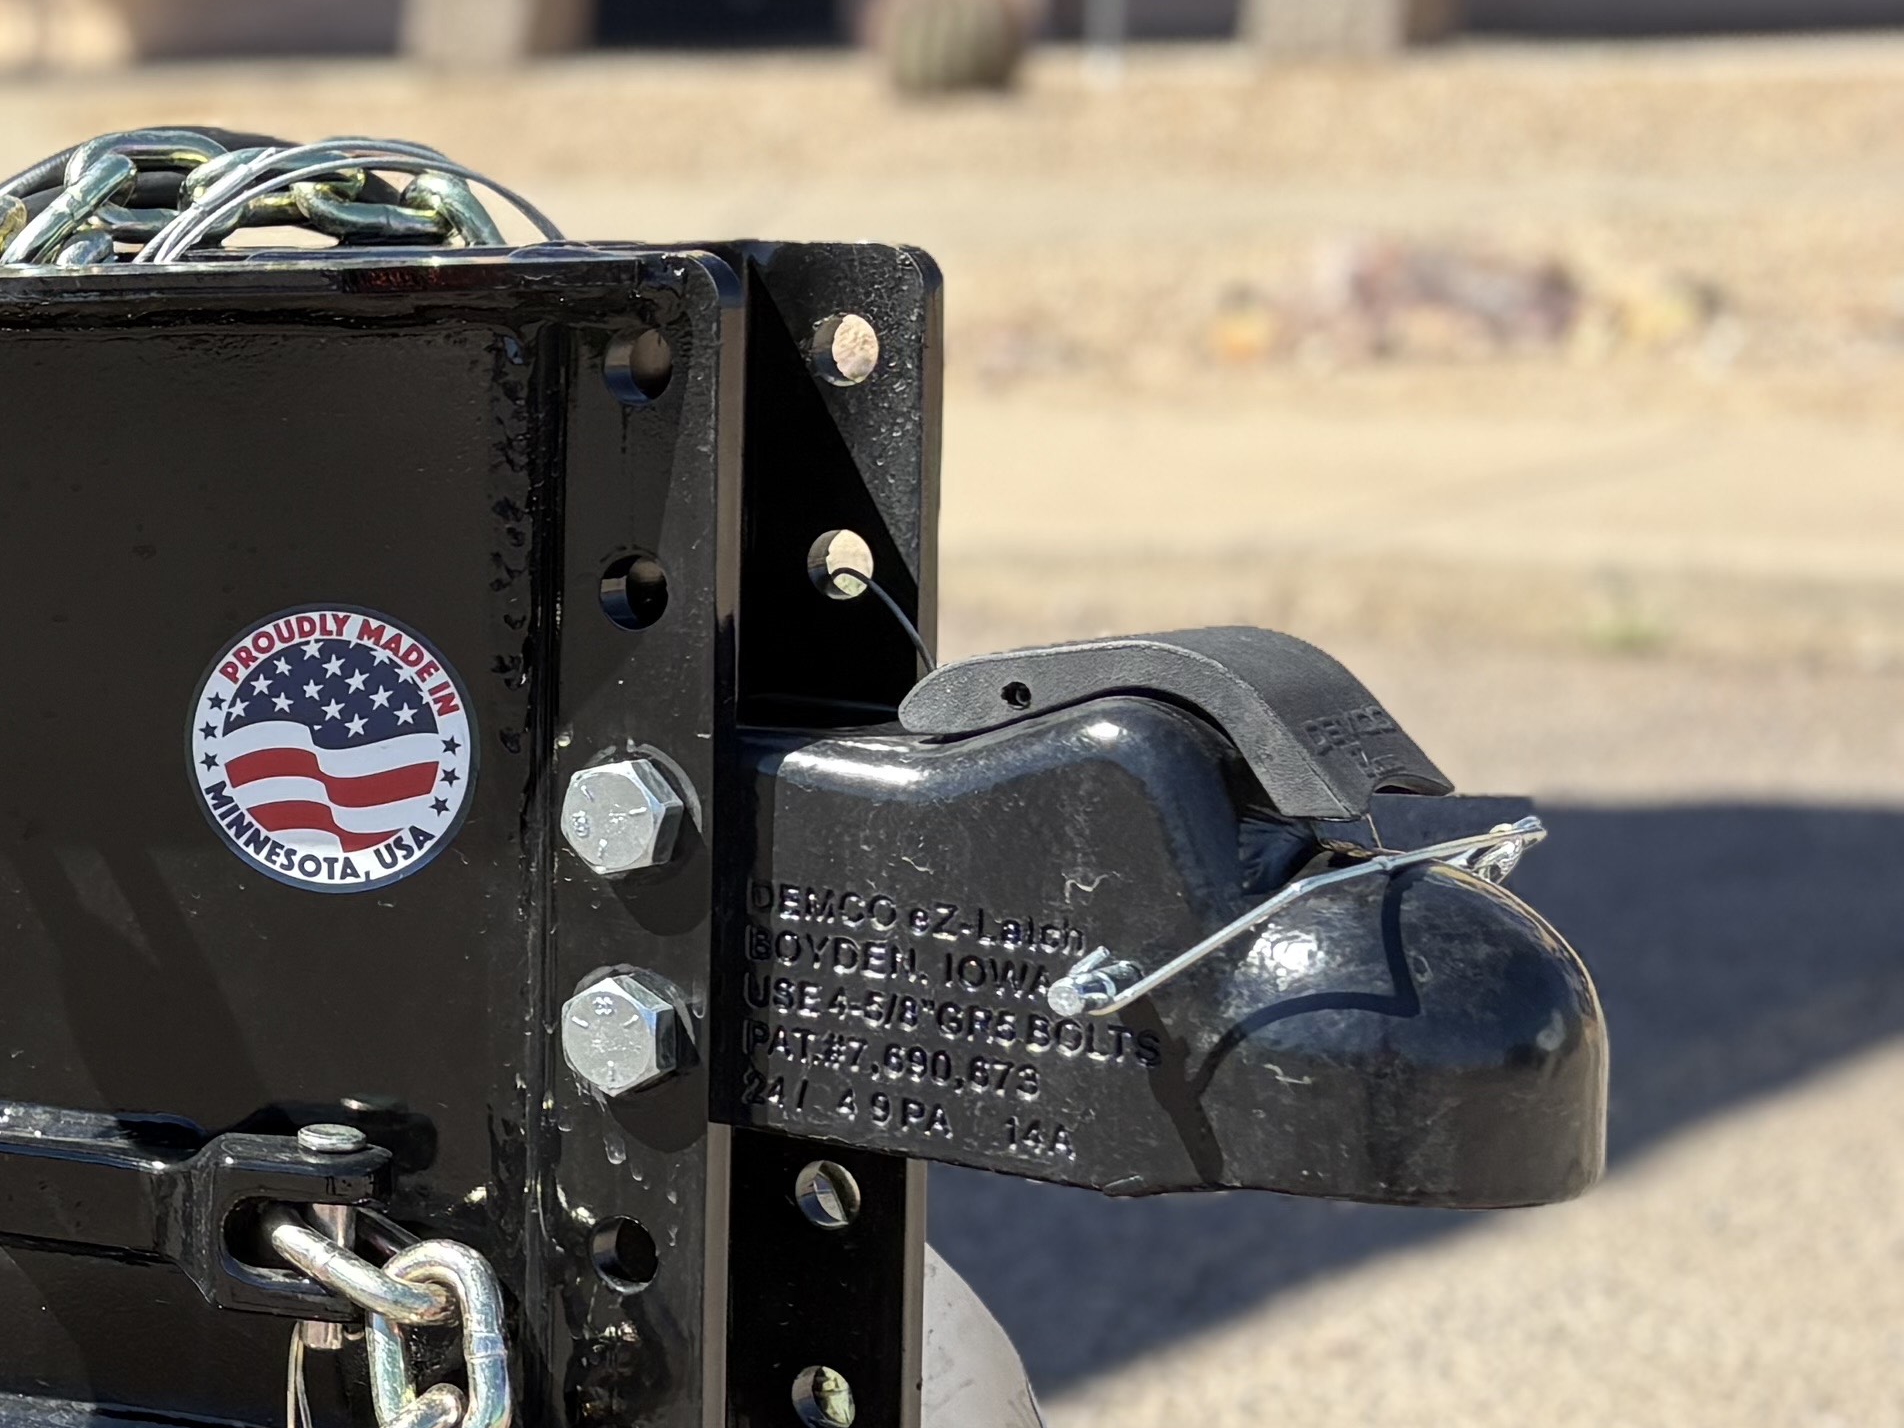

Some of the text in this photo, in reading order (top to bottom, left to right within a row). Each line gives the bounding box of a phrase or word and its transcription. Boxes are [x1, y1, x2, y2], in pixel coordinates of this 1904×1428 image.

[219, 613, 461, 717] PROUDLY MADE IN
[204, 780, 436, 882] MINNESOTA, USA
[747, 880, 898, 932] DEMCO
[744, 971, 823, 1018] USE
[1024, 1012, 1162, 1069] BOLTS
[944, 951, 1053, 1002] IOWA
